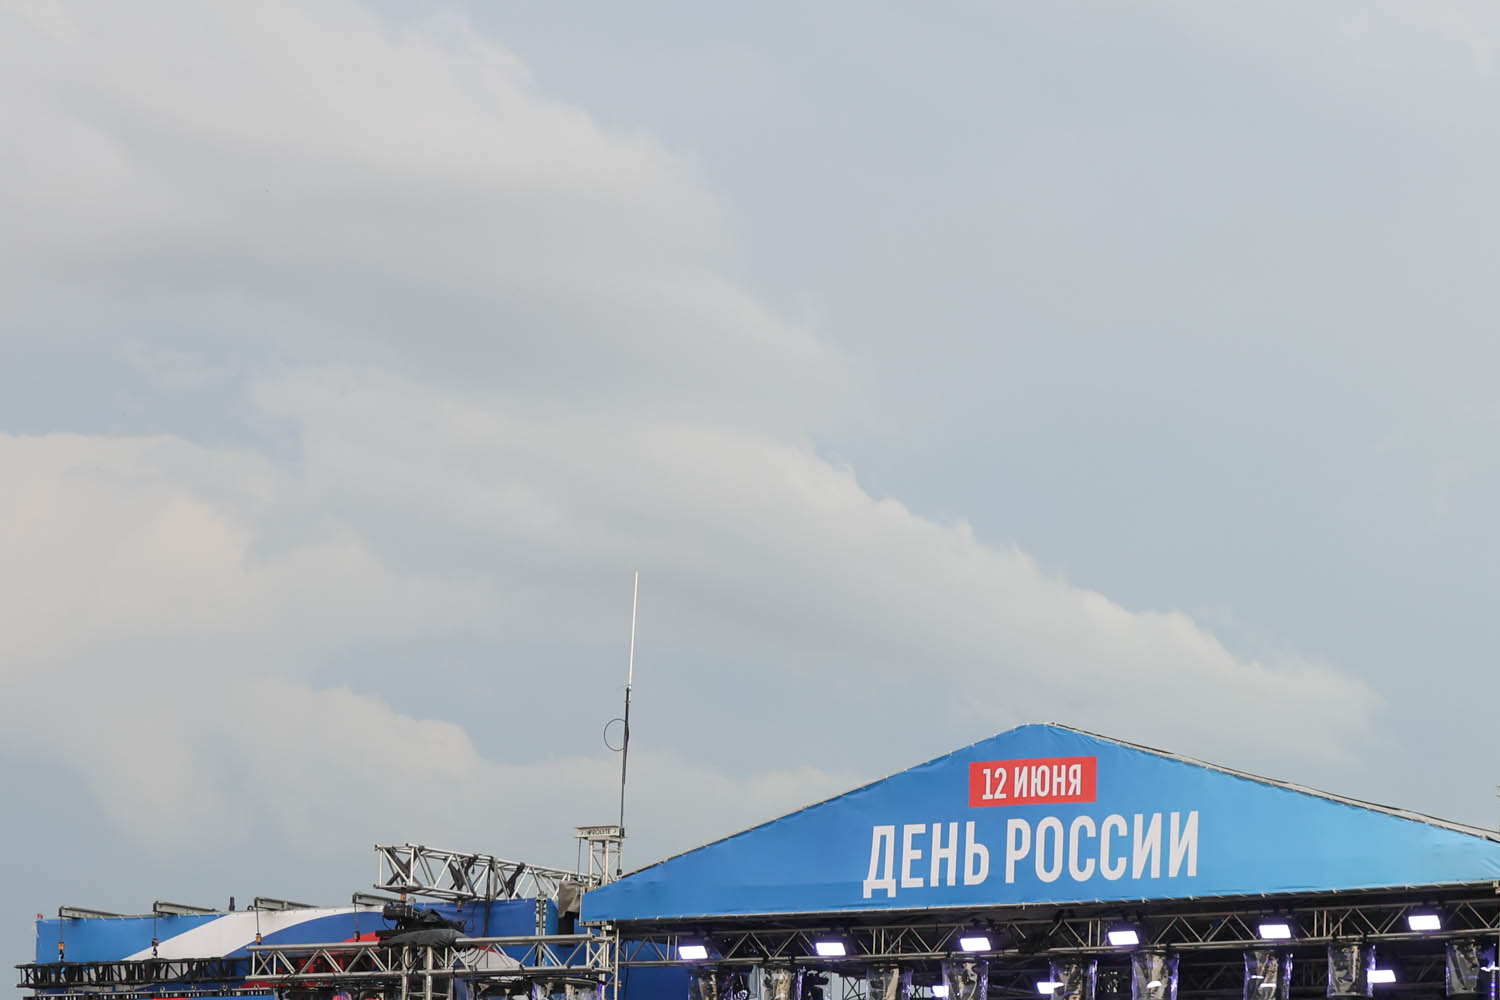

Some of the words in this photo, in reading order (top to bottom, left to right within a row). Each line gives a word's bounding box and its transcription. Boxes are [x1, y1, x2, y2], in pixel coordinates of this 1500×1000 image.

[982, 767, 1007, 801] 12
[1013, 764, 1082, 799] ИЮНЯ
[862, 820, 990, 899] ДЕНЬ
[1005, 810, 1199, 884] РОССИИ
